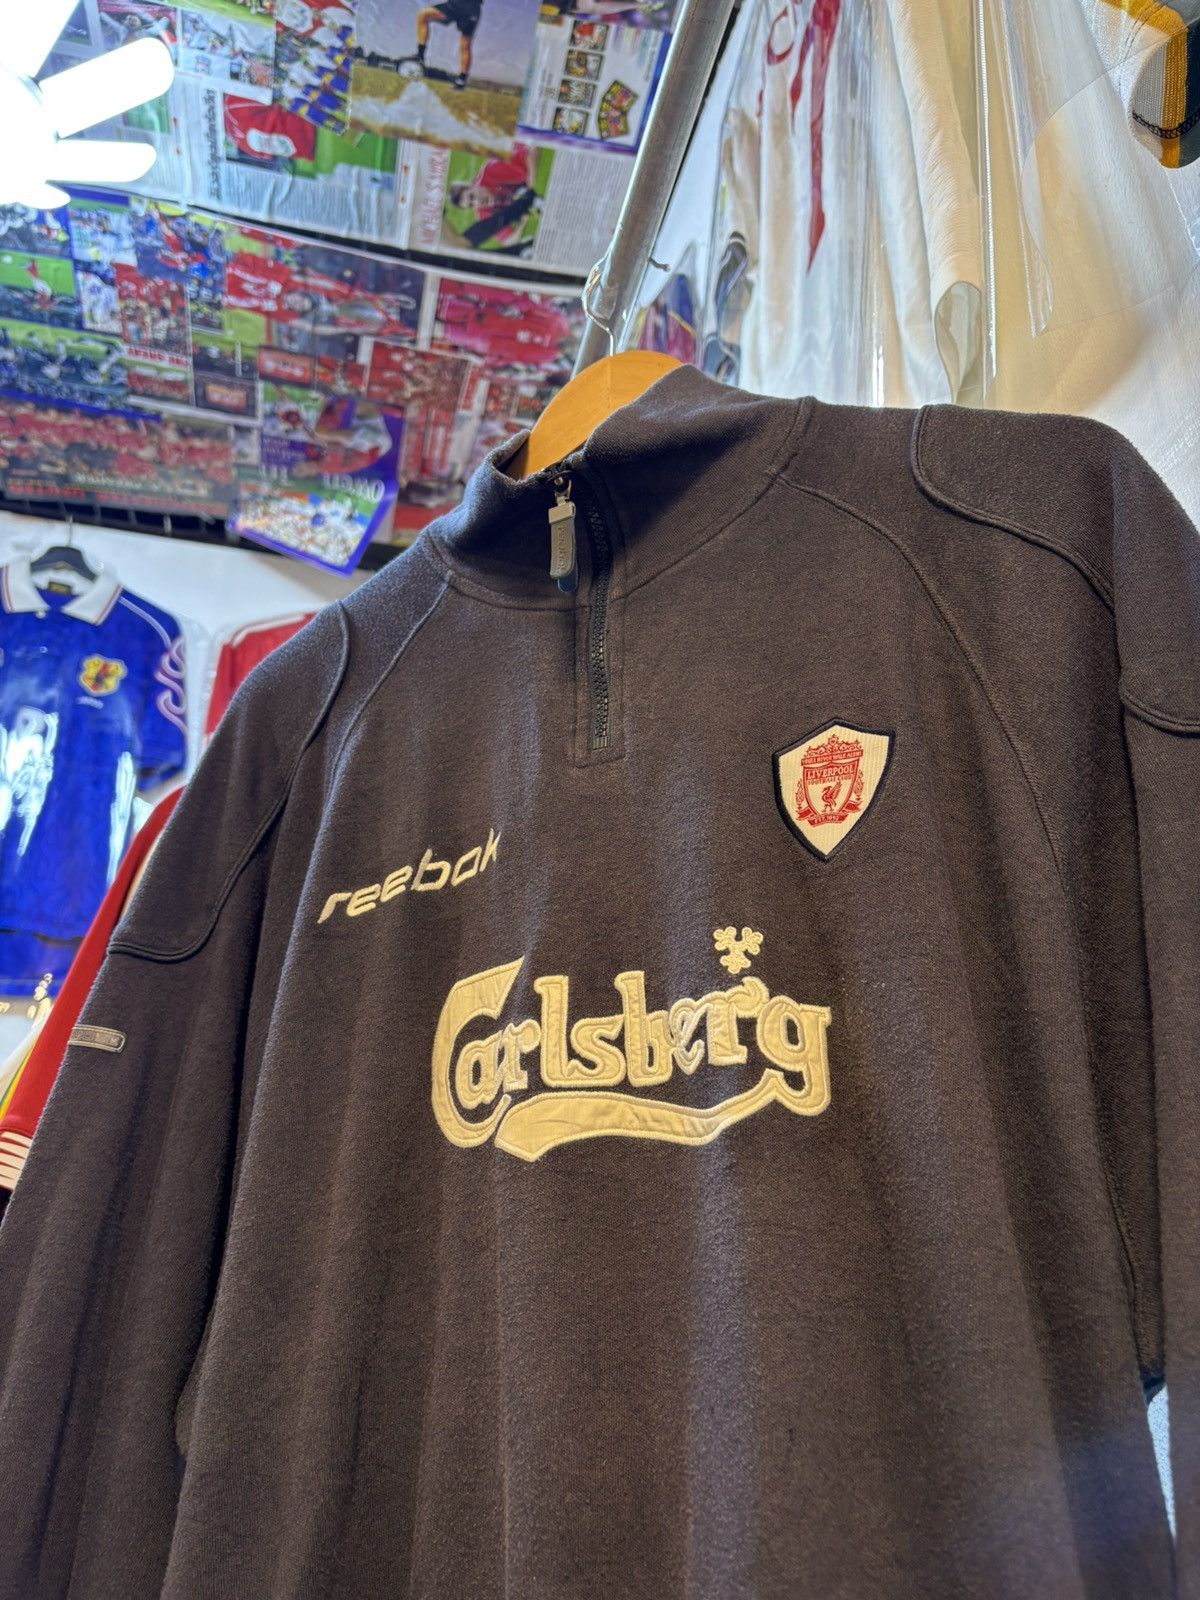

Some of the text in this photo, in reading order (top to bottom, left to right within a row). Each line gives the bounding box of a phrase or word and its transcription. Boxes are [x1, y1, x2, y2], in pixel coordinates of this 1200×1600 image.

[807, 765, 854, 779] LIVERPOOL
[317, 829, 500, 923] reebok
[432, 956, 831, 1162] Carlsberg
